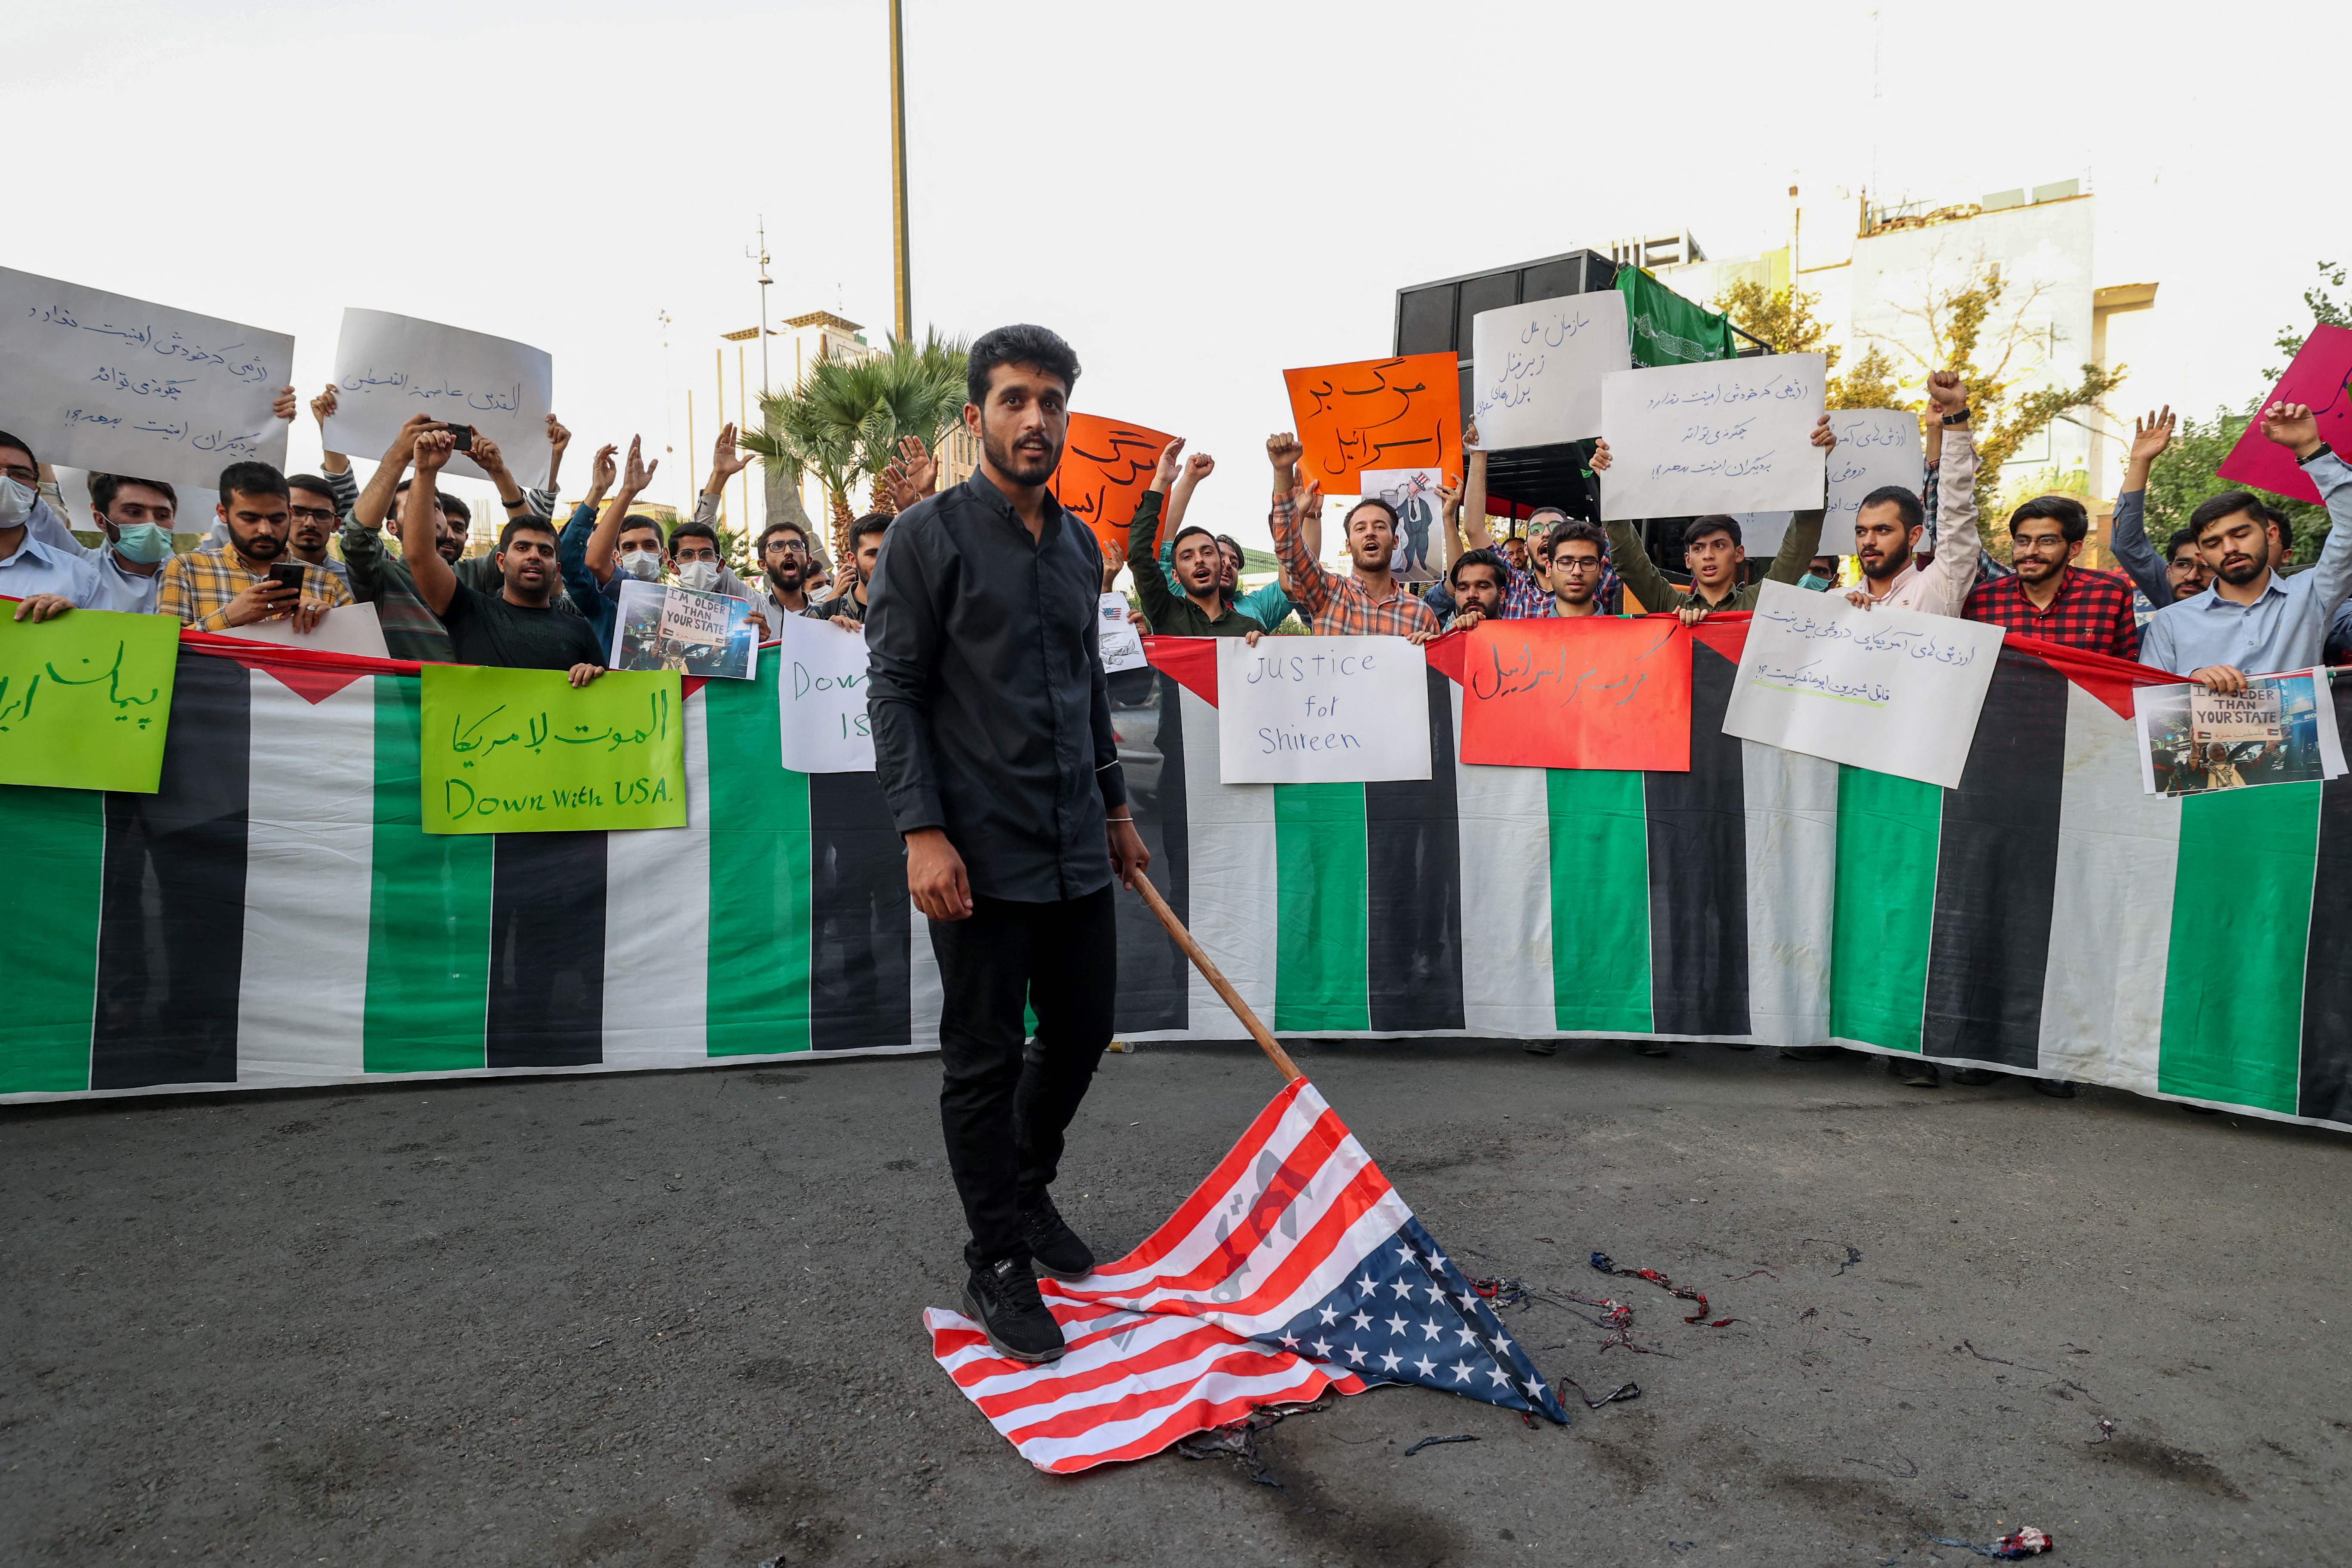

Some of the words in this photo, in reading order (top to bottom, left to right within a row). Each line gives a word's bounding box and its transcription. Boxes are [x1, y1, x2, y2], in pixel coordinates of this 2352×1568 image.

[1522, 321, 1539, 343] ملل
[1545, 311, 1589, 346] سازمان
[468, 383, 521, 419] القدس
[1305, 380, 1332, 420] بر
[1342, 358, 1426, 429] مرگ
[668, 588, 688, 603] I'M
[695, 597, 725, 615] OLDER
[682, 605, 711, 620] THAN
[667, 610, 692, 628] YOUR
[695, 619, 724, 634] STATE
[45, 640, 158, 730] پیمان
[794, 662, 873, 701] Dow
[1305, 695, 1338, 717] for
[2197, 711, 2233, 723] YOUR
[2235, 711, 2276, 723] STATE
[2214, 700, 2256, 709] THAN
[554, 689, 668, 752] الموت
[1259, 725, 1361, 754] Shireen
[445, 779, 547, 820] Down
[998, 1262, 1012, 1274] NIKE
